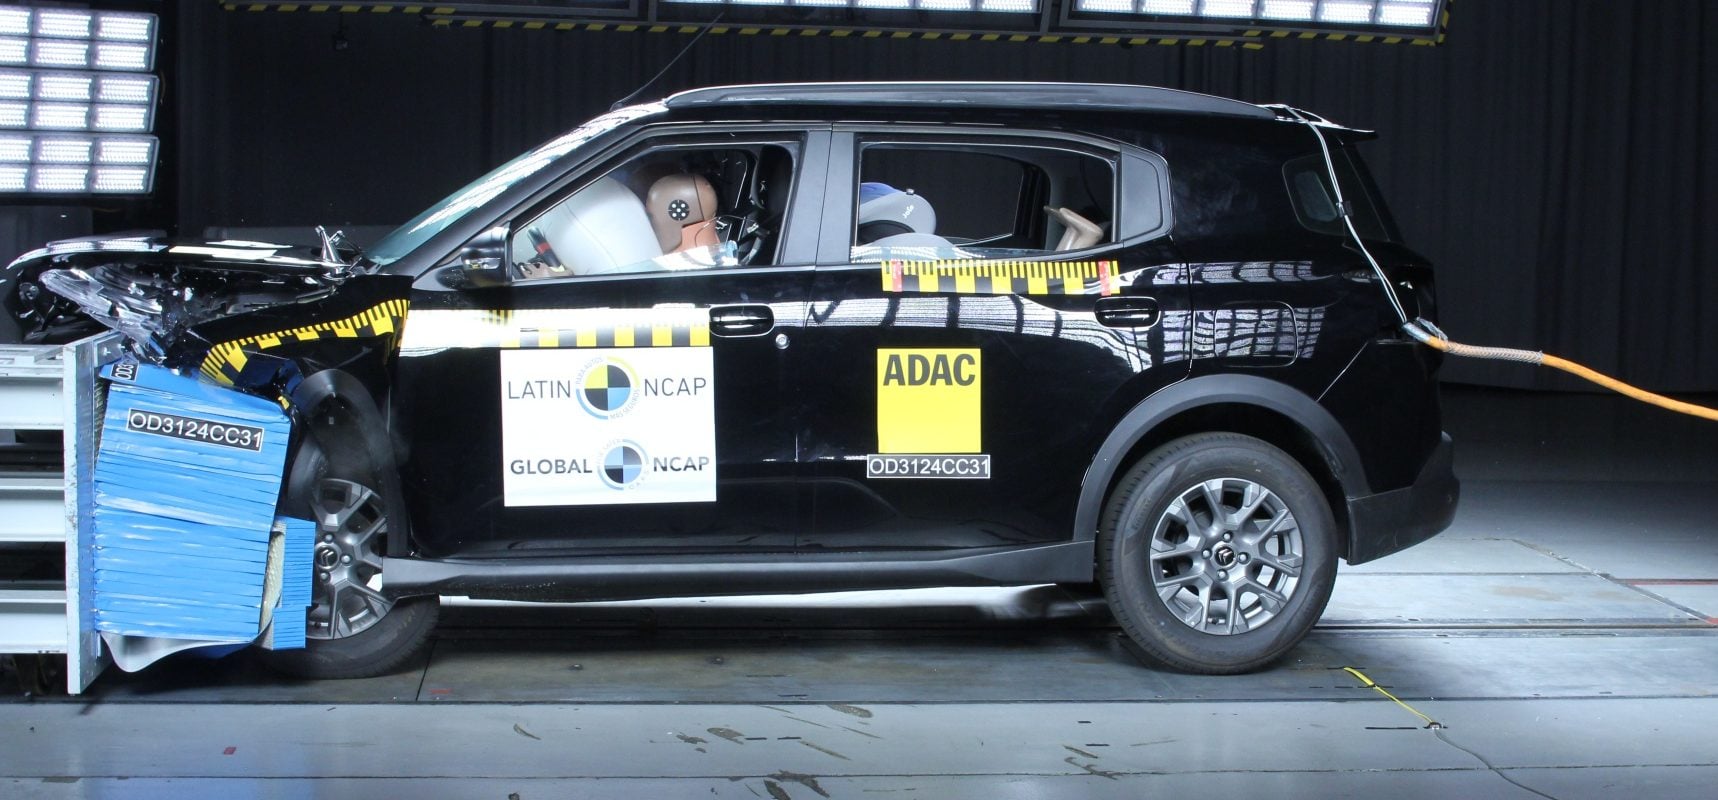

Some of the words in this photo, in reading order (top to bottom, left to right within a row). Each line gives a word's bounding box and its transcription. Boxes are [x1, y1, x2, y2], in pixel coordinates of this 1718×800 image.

[882, 353, 976, 387] ADAC
[508, 380, 571, 399] LATIN
[644, 377, 707, 397] NCAP
[130, 412, 262, 448] OD3124CC31
[510, 458, 592, 475] GLOBAL
[653, 456, 710, 472] NCAP
[869, 458, 989, 475] OD3124CC31
